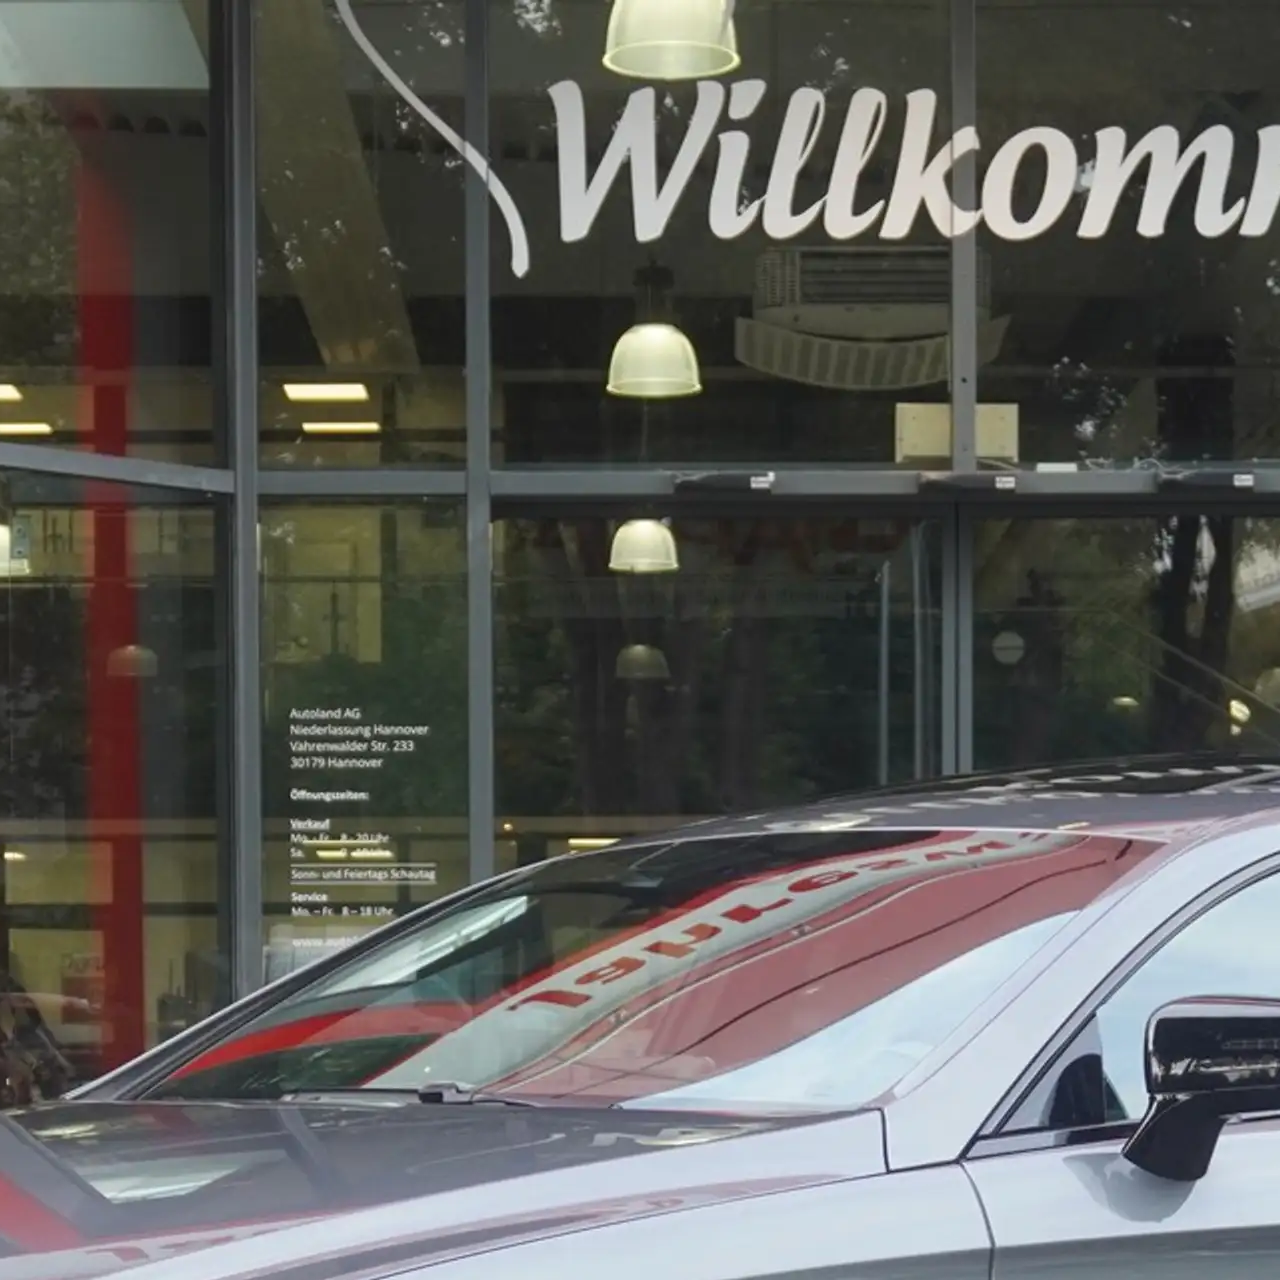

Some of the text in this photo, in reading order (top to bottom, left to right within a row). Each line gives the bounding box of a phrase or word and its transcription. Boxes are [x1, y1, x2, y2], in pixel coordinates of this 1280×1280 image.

[289, 707, 361, 719] Autoland AG
[289, 724, 429, 738] Niederlassung Hannover
[289, 740, 414, 751] Vahrenwalder Str. 233
[290, 756, 383, 768] 30179 Hannover
[289, 818, 330, 830] Verkauf
[291, 868, 436, 881] Sonn- und Feiertags Schautag
[291, 892, 328, 903] Service
